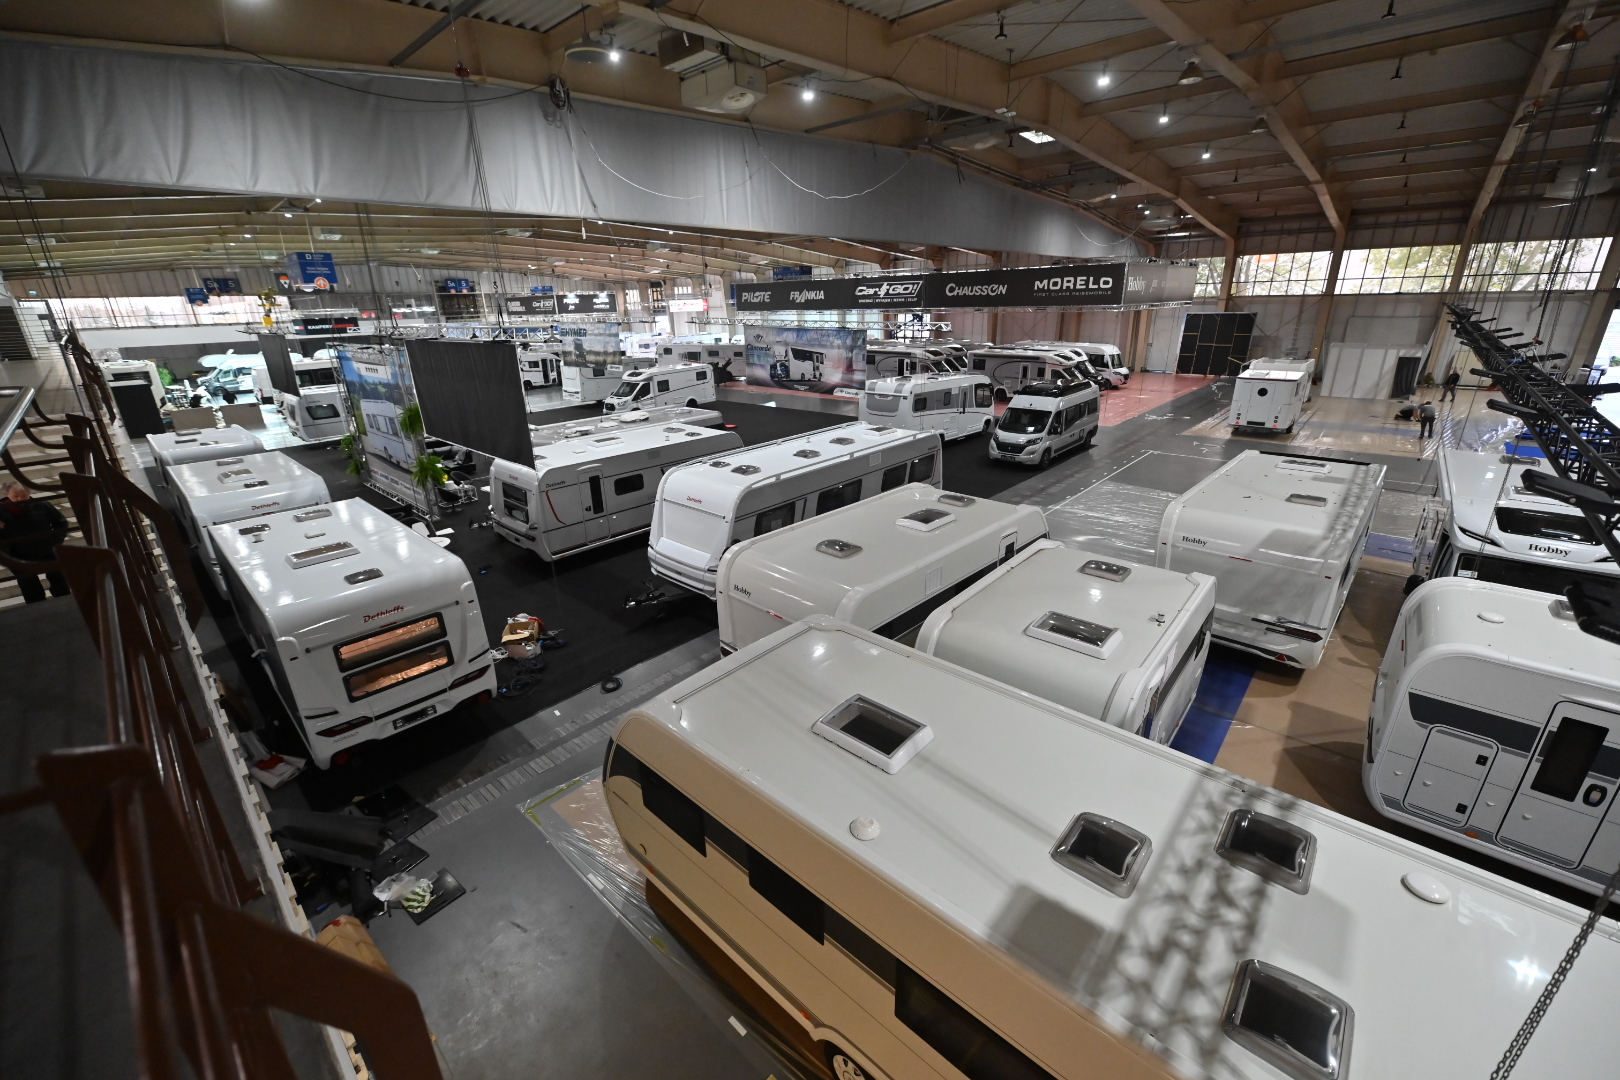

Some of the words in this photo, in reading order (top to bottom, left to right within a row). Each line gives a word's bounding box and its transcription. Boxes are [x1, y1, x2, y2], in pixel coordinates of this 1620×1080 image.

[945, 283, 1008, 297] CHAUSSON
[1034, 276, 1113, 290] MORELO
[1127, 276, 1146, 295] Hobby
[789, 289, 825, 303] FRANKIA
[565, 328, 587, 337] HYMER
[746, 343, 772, 352] Concorde
[1182, 535, 1208, 547] Hobby
[1528, 543, 1571, 557] Hobby
[734, 584, 751, 598] Hobby
[362, 605, 405, 623] Dethleffs
